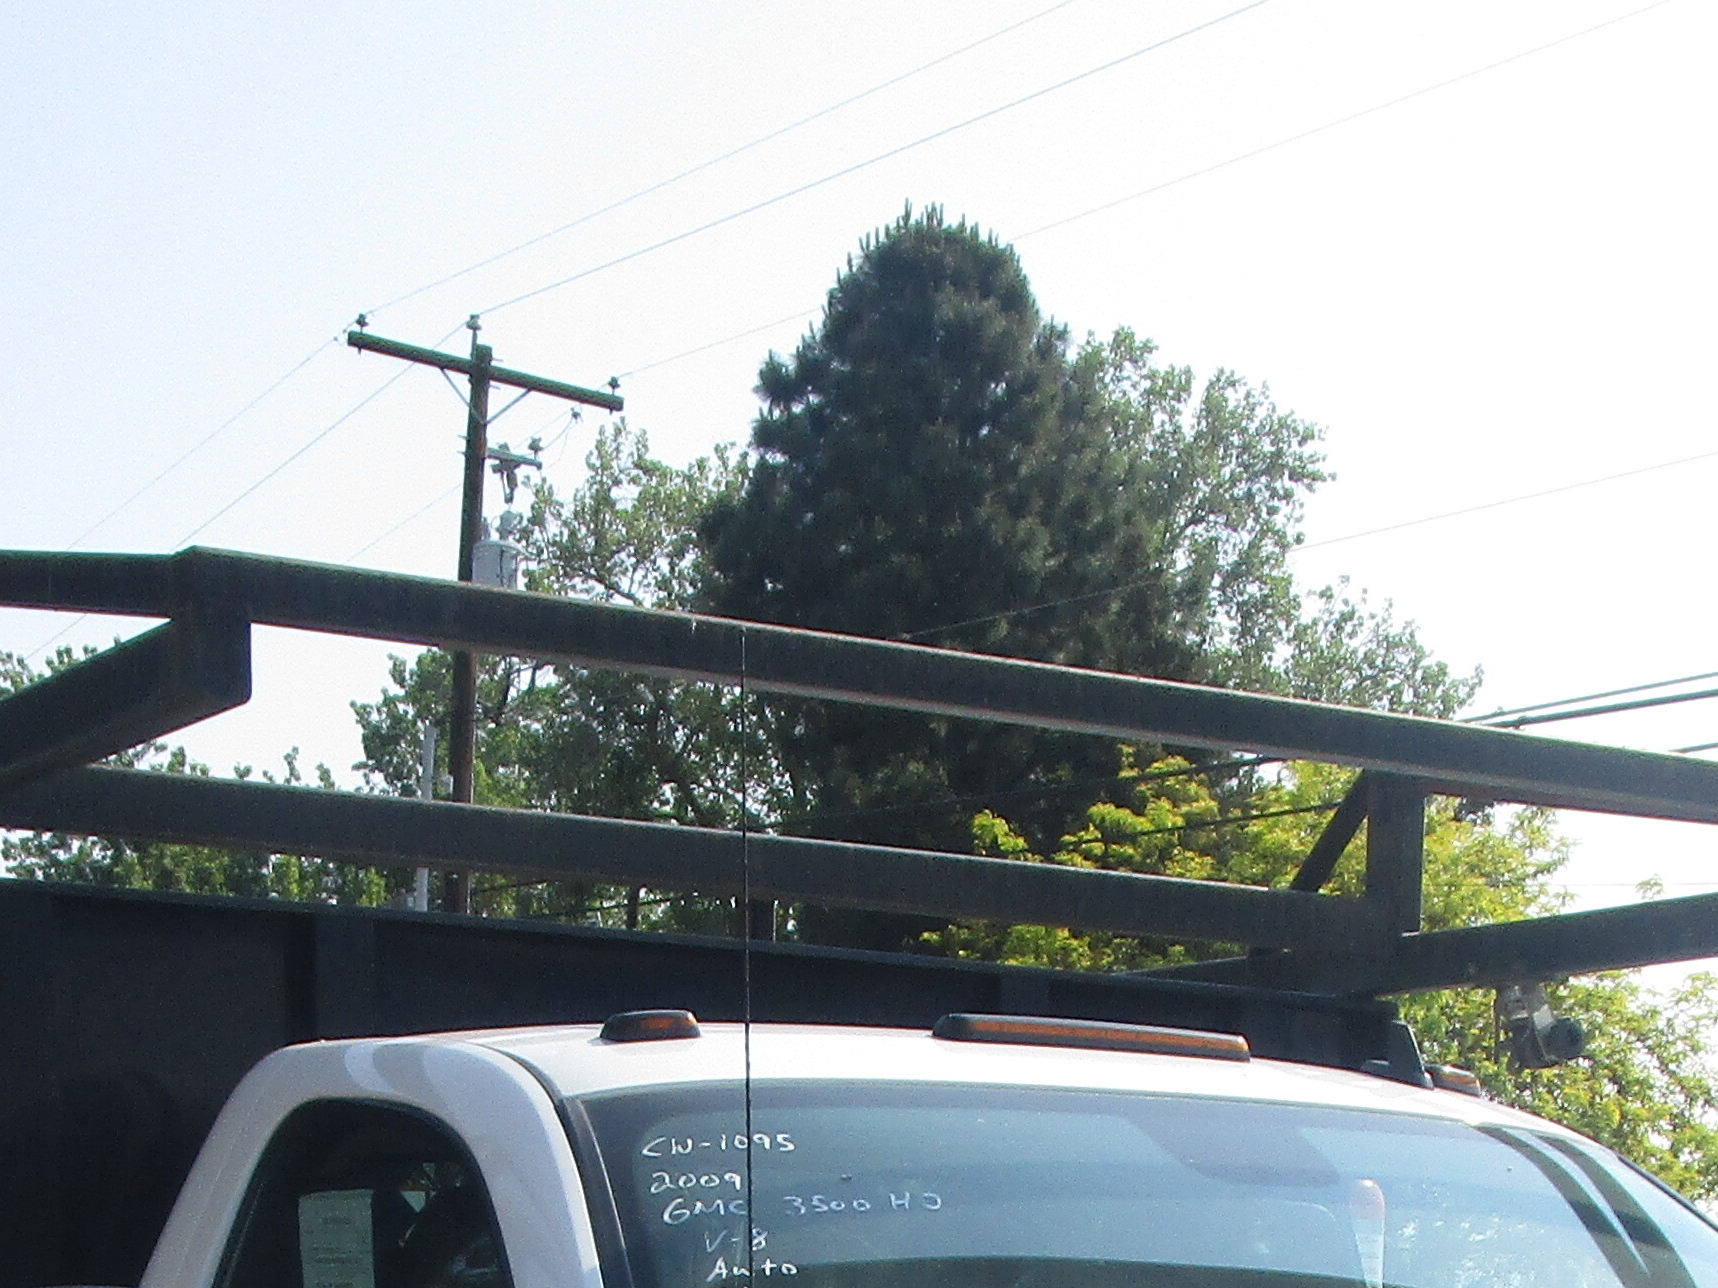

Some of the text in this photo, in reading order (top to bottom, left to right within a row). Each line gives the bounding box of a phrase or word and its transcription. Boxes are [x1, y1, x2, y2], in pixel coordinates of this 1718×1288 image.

[650, 1171, 743, 1195] 2009
[662, 1198, 748, 1225] GMC
[783, 1195, 871, 1216] 3500
[704, 1228, 768, 1253] V-8
[706, 1256, 798, 1283] Auto
